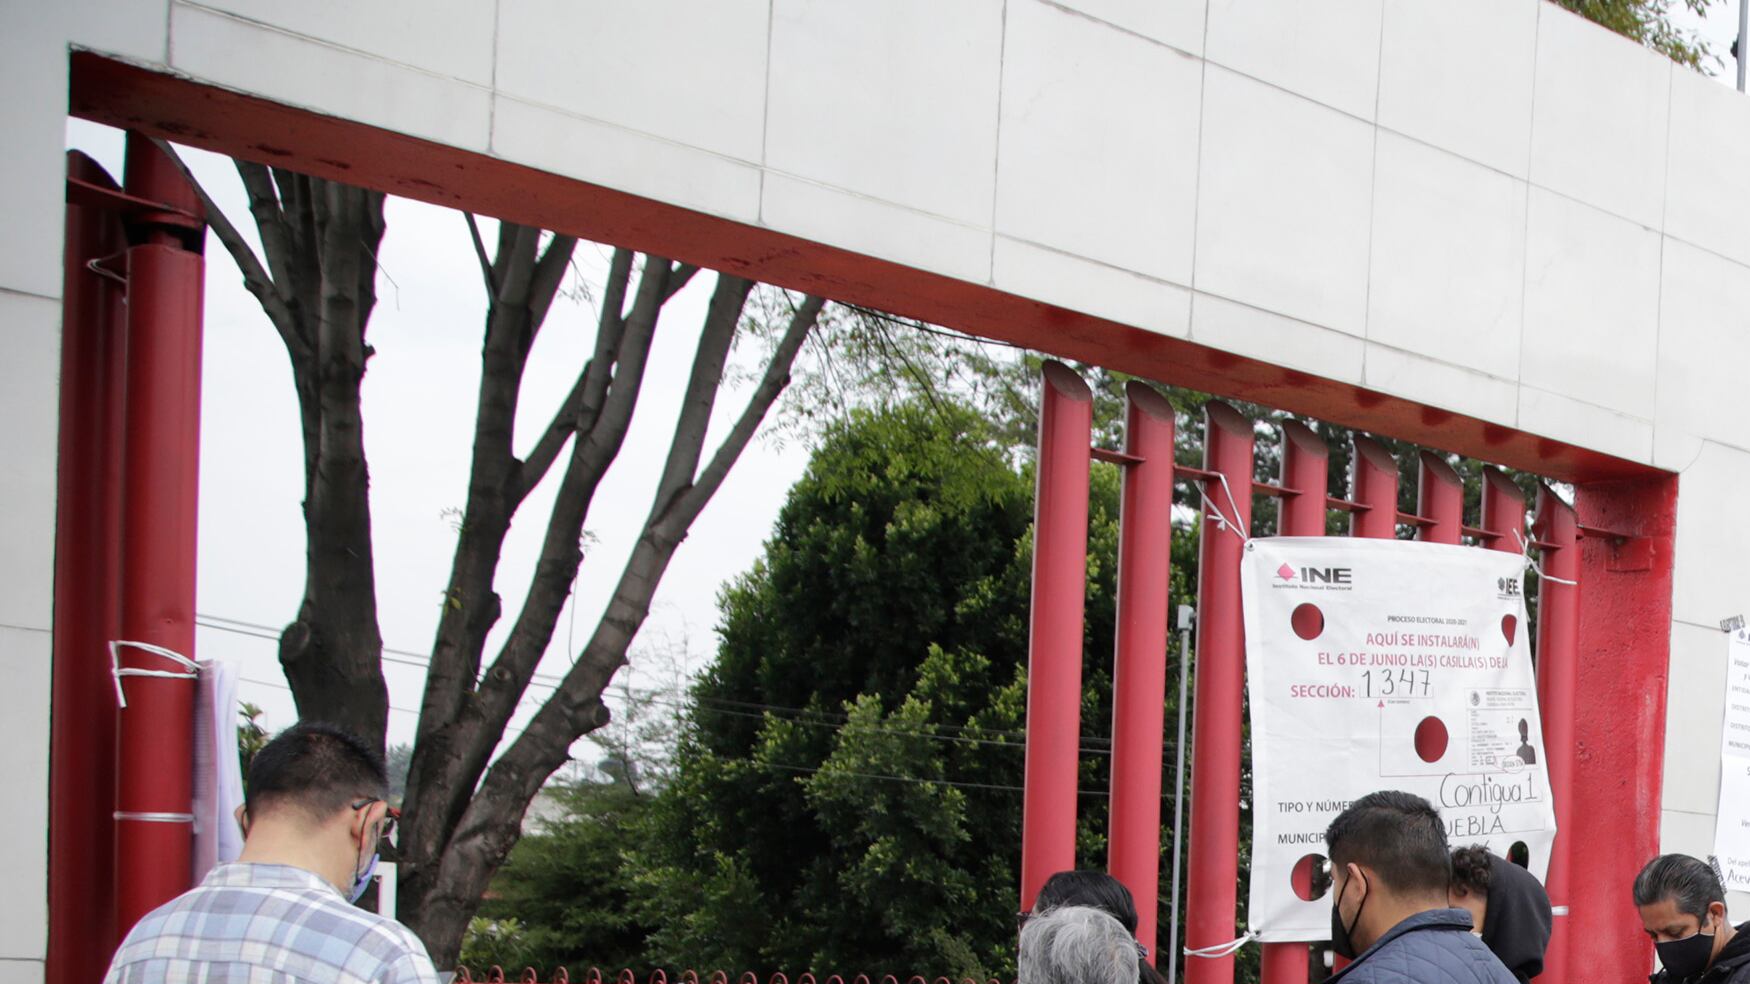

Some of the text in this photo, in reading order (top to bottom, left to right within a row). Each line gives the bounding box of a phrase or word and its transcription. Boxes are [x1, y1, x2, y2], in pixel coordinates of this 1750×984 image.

[1301, 567, 1352, 584] INE
[1387, 615, 1415, 623] PROCESO
[1416, 617, 1444, 625] ELECTORAL
[1366, 630, 1480, 651] AQUÍ SE INSTALARÁ(N)
[1318, 653, 1334, 665] EL
[1337, 652, 1346, 665] 6
[1349, 653, 1366, 665] DE
[1369, 653, 1408, 666] JUNIO
[1410, 654, 1437, 668] LA(S)
[1440, 655, 1488, 669] CASILLA(S)
[1291, 682, 1355, 698] SECCIÓN:
[1361, 668, 1431, 697] 1347
[1440, 772, 1537, 814] Contigua 1
[1278, 799, 1353, 812] TIPO Y NÚMER
[1446, 815, 1507, 837] UEBLA
[1278, 833, 1326, 844] MUNICIP
